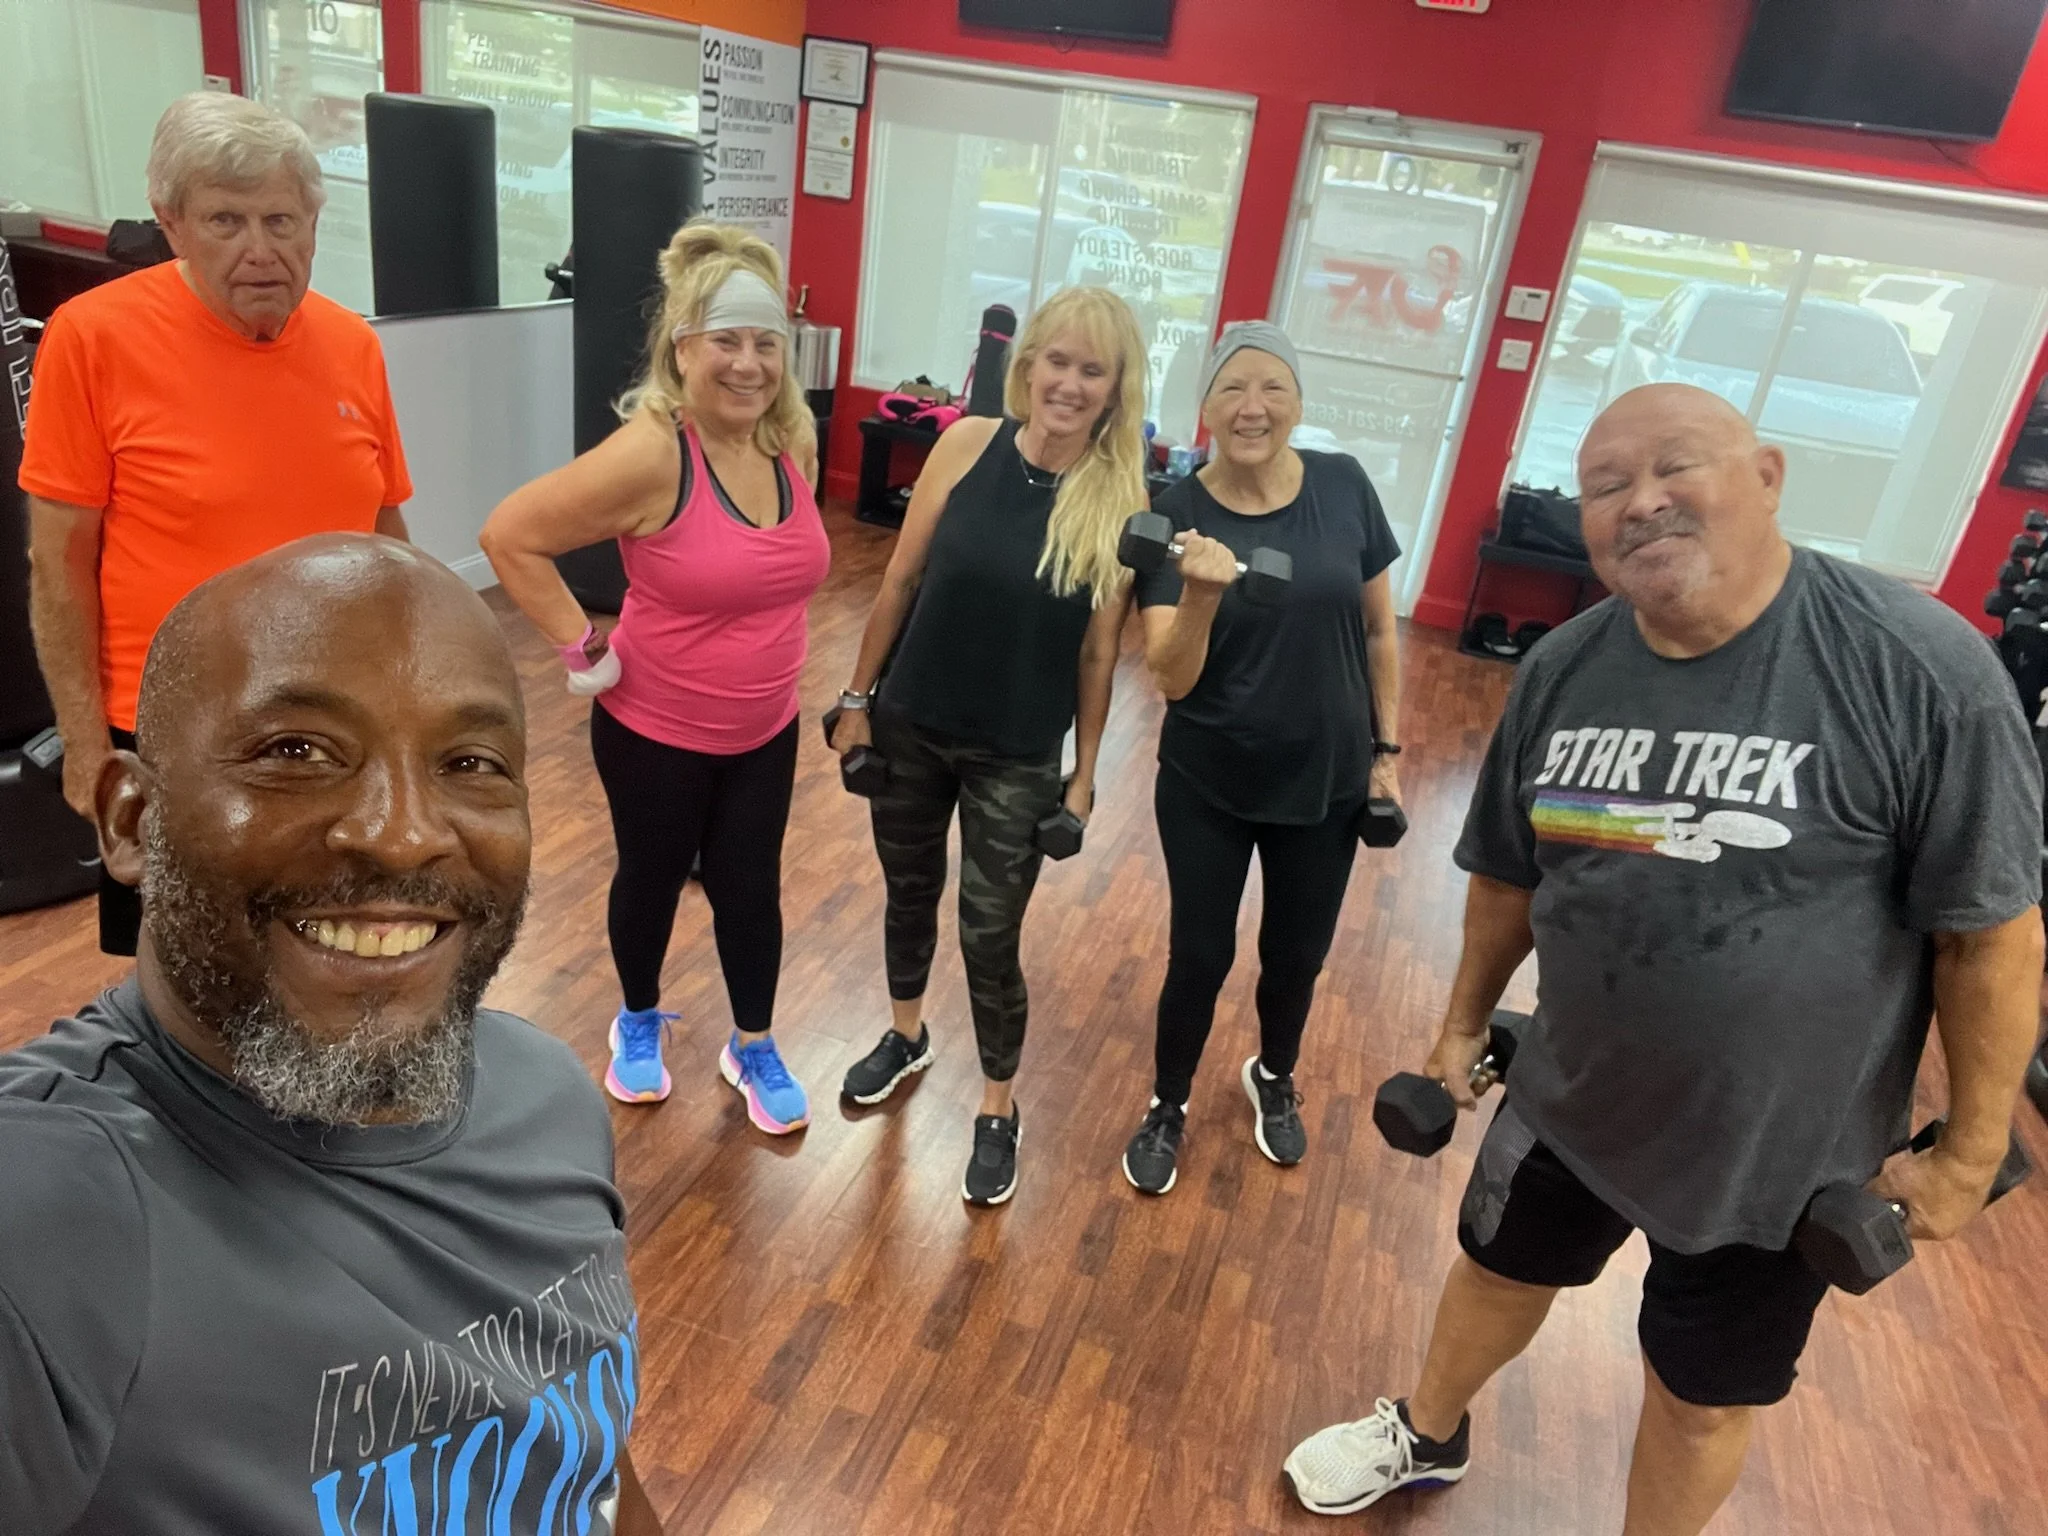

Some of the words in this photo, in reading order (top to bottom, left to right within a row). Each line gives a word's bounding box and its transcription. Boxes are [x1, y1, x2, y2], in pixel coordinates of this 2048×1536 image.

[472, 51, 541, 78] TRAINING
[723, 42, 763, 71] PASSION
[702, 38, 721, 186] VALUES
[721, 95, 795, 125] COMMUNICATION
[719, 147, 765, 170] INTEGRITY
[1534, 726, 1656, 792] STAR
[1664, 731, 1818, 810] TREK
[310, 1355, 391, 1474] IT'S
[388, 1341, 506, 1449] NEVER
[458, 1306, 536, 1390] TOO
